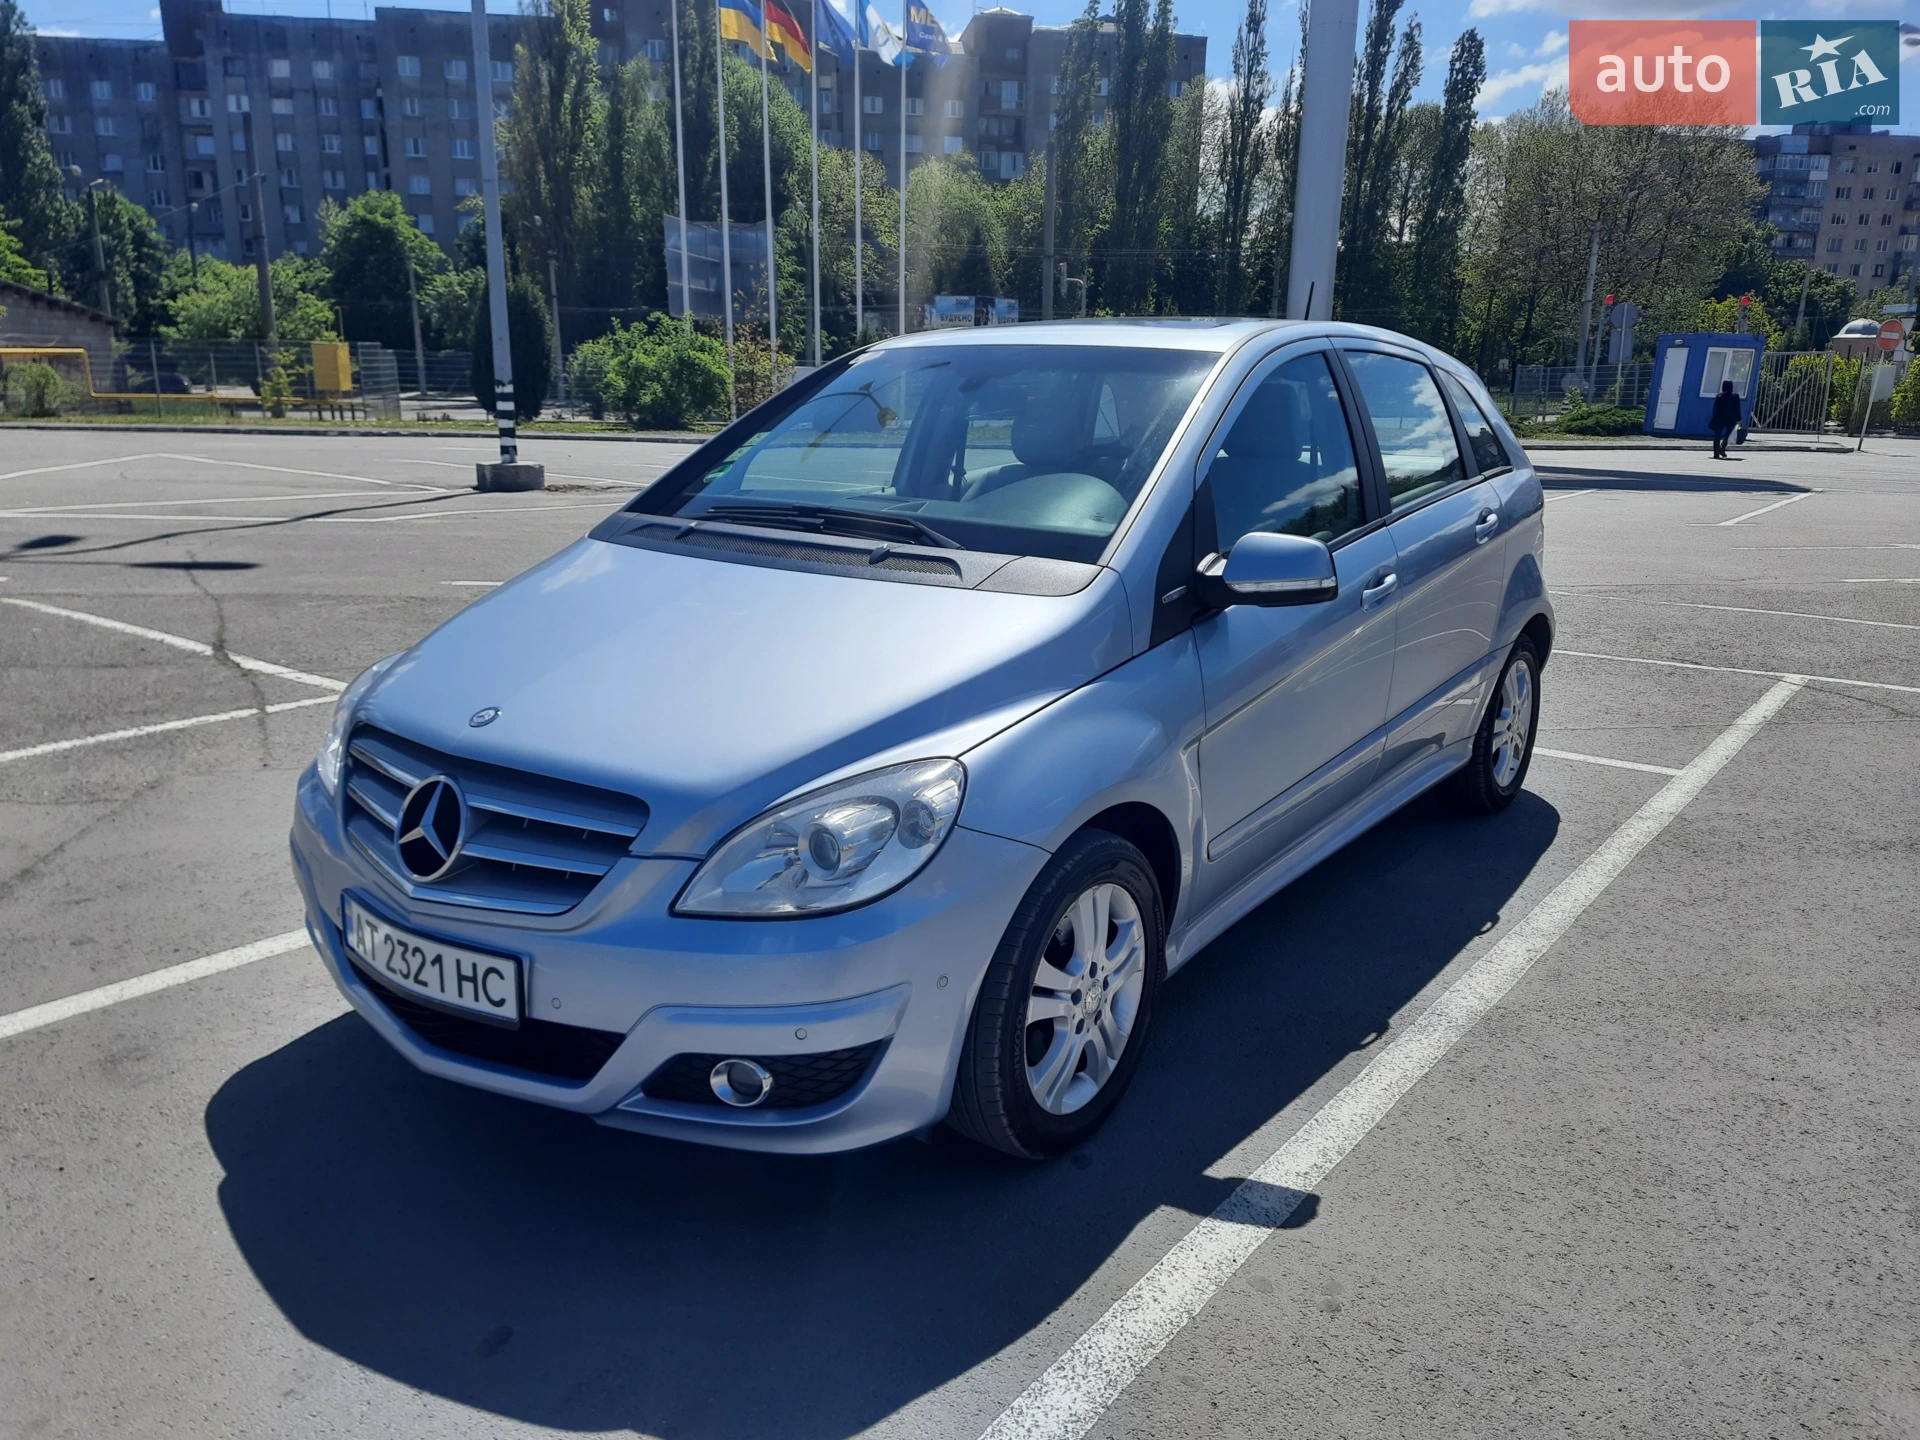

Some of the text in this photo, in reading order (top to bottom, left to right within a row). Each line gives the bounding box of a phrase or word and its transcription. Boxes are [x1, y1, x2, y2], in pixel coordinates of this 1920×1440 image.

[356, 912, 507, 1008] AT 2321 HC
